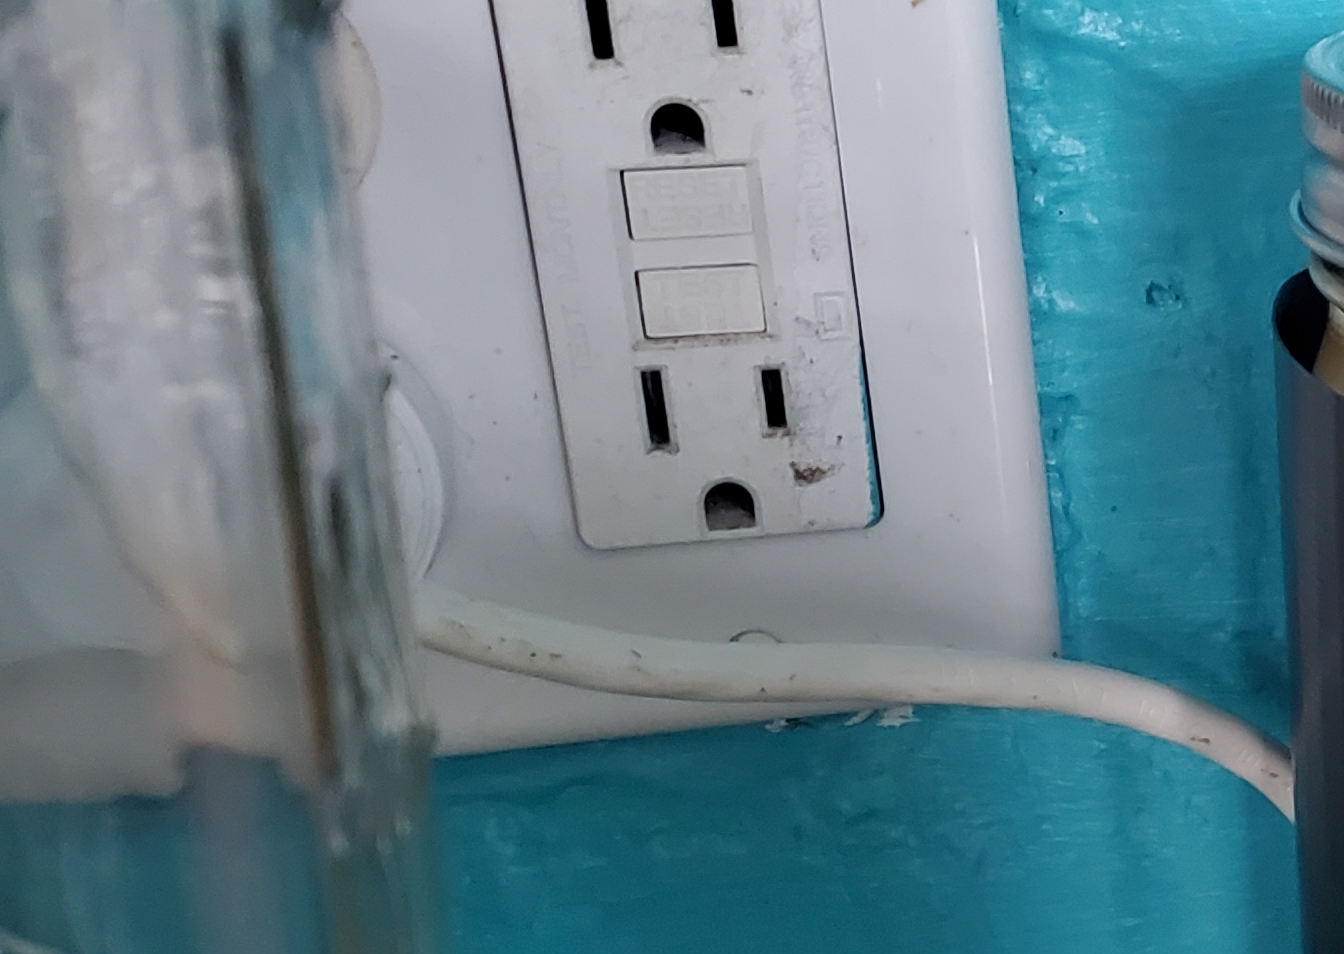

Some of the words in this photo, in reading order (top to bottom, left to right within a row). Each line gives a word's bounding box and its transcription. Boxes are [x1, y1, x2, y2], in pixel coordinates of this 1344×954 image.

[630, 175, 742, 200] RESET
[641, 203, 749, 232] RESET
[653, 273, 746, 301] TEST
